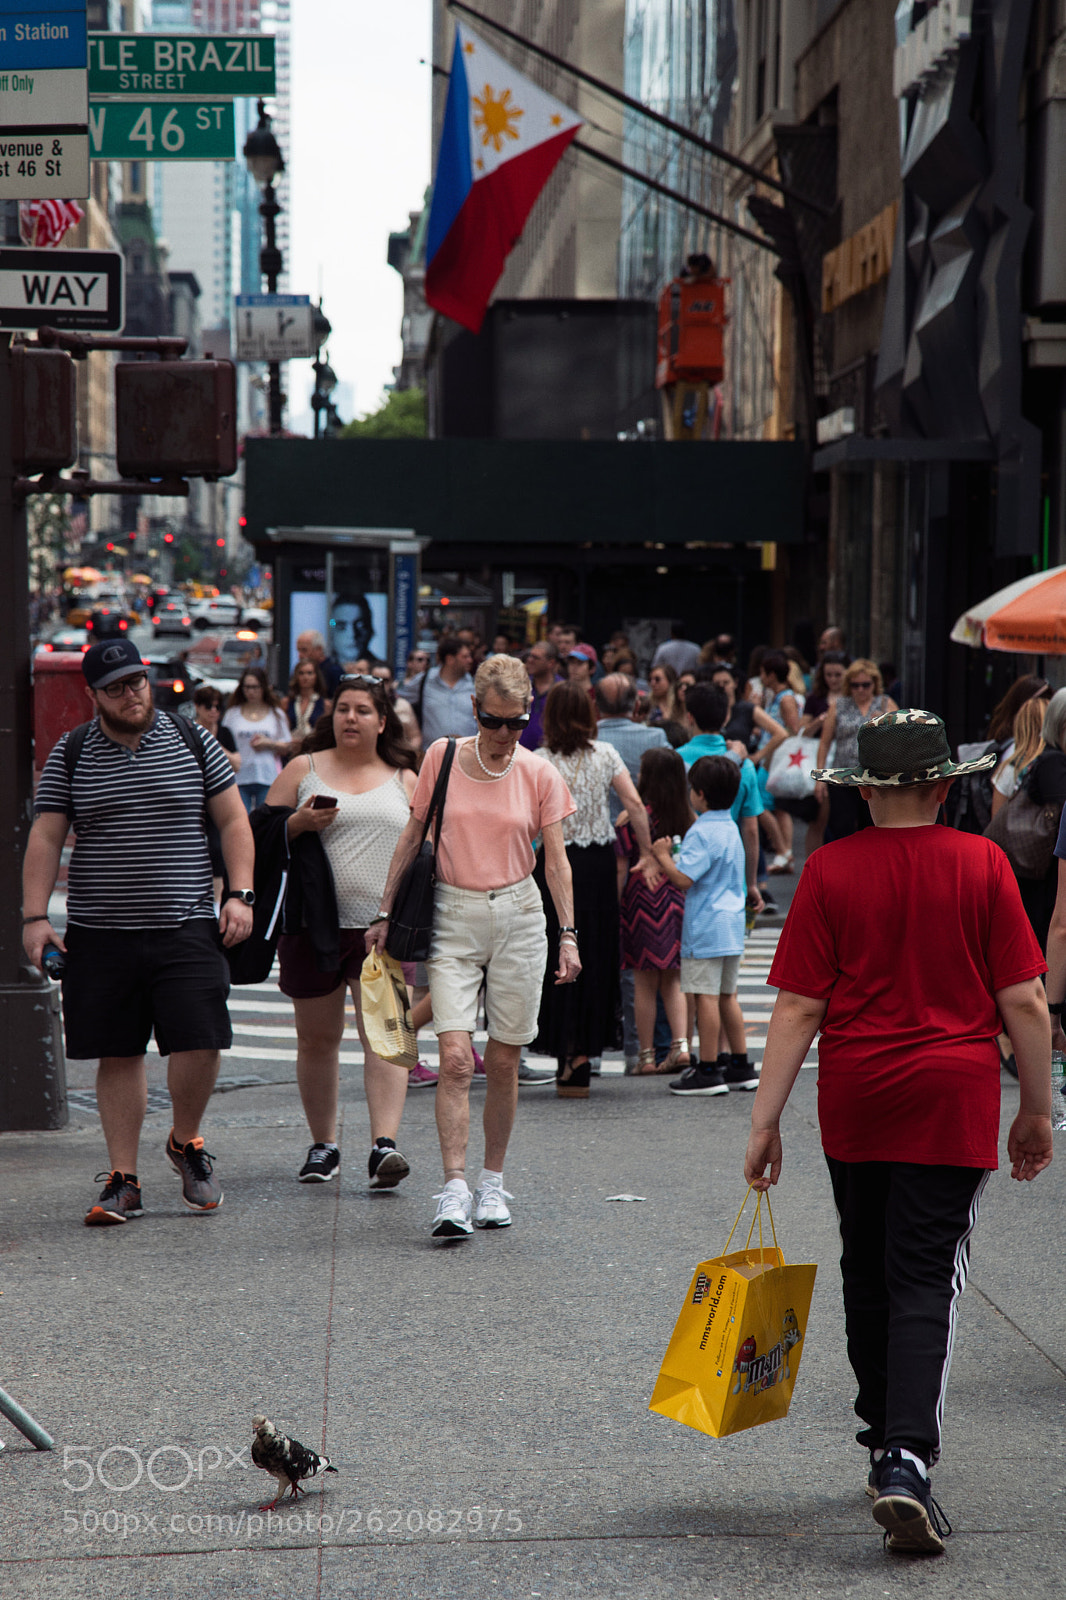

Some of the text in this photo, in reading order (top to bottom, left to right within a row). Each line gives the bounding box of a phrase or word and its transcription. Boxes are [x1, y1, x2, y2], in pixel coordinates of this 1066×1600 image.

[15, 22, 69, 41] Station
[154, 40, 272, 72] BRAZIL
[12, 74, 34, 95] Only
[119, 73, 186, 89] STREET
[129, 107, 185, 152] 46
[196, 107, 225, 130] ST
[51, 139, 63, 156] &
[17, 160, 36, 177] 46
[45, 160, 61, 176] St
[22, 274, 99, 306] WAY
[699, 1275, 727, 1350] mmsworld.com
